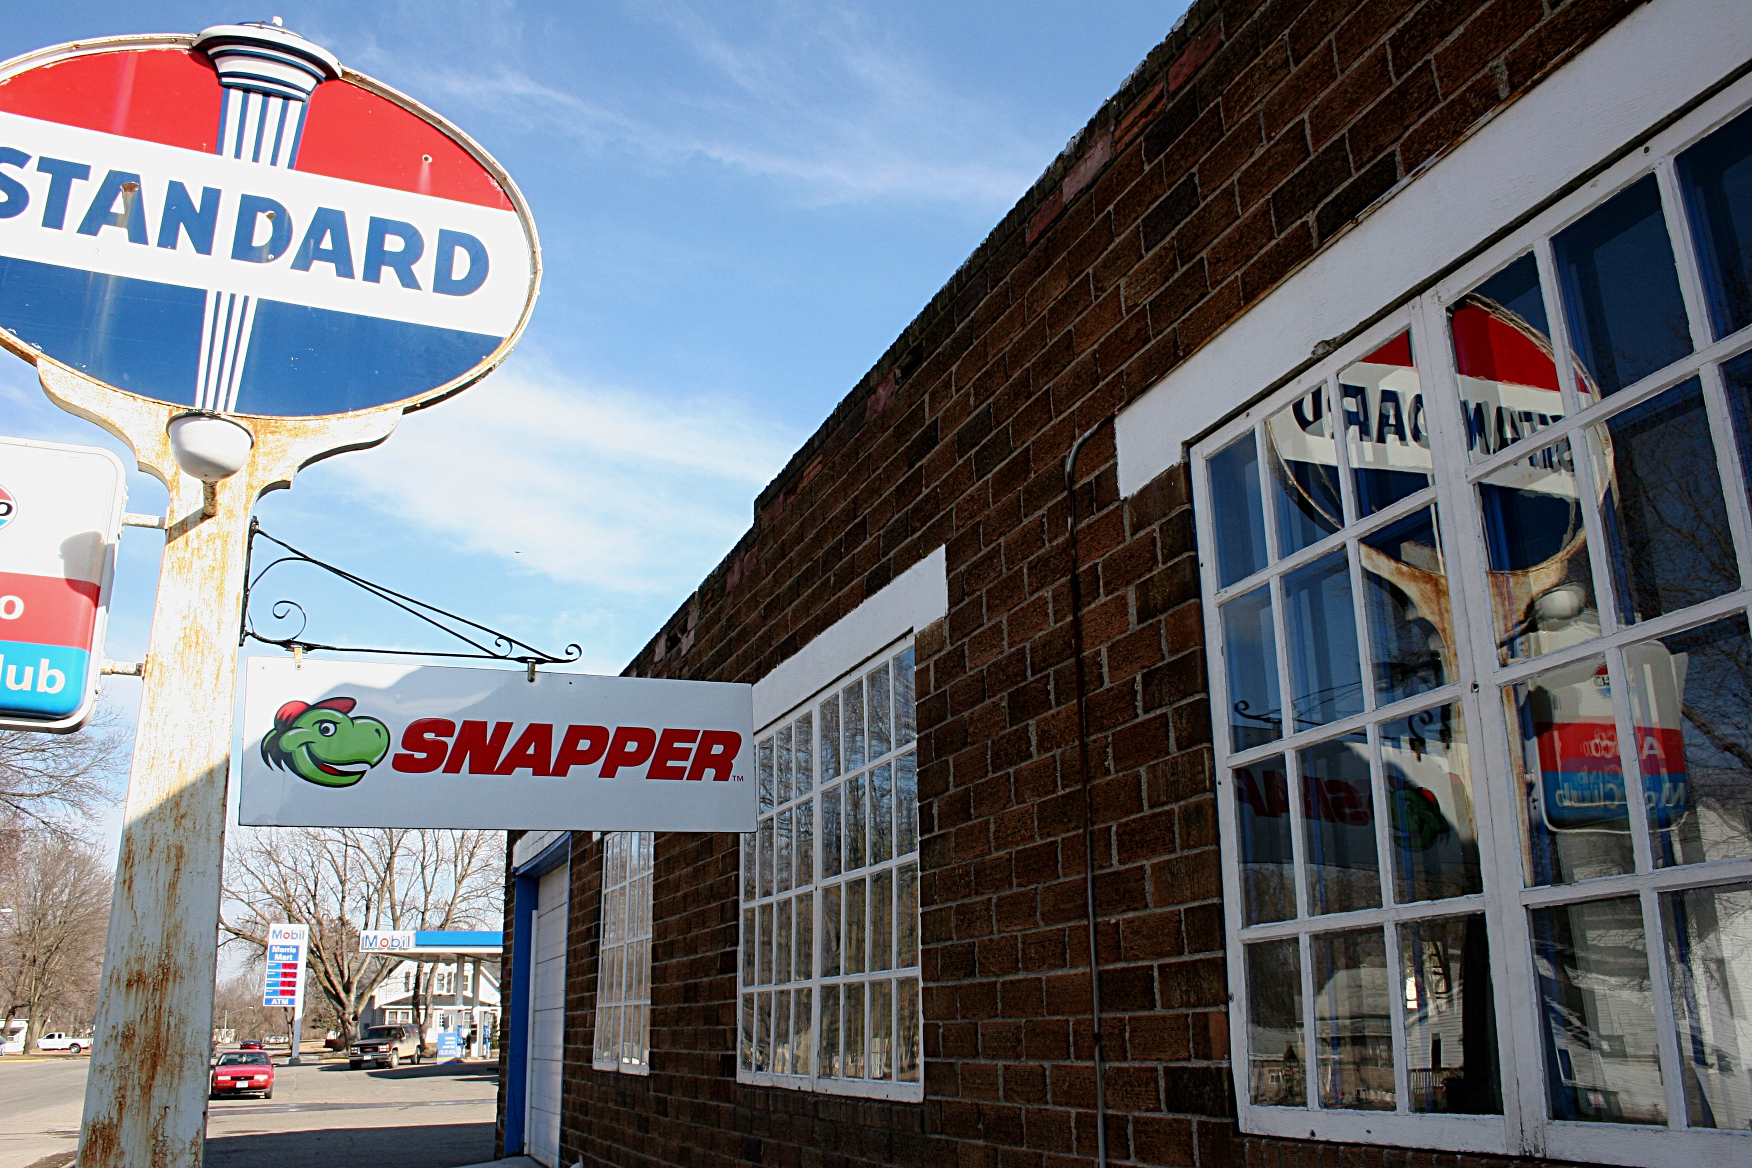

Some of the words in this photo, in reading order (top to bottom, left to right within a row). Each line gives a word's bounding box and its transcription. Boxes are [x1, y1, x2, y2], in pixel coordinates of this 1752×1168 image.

[0, 146, 490, 297] STANDARD
[391, 717, 742, 782] SNAPPER
[271, 929, 305, 940] Mobil
[364, 934, 410, 948] Mobil
[272, 945, 297, 953] Morris
